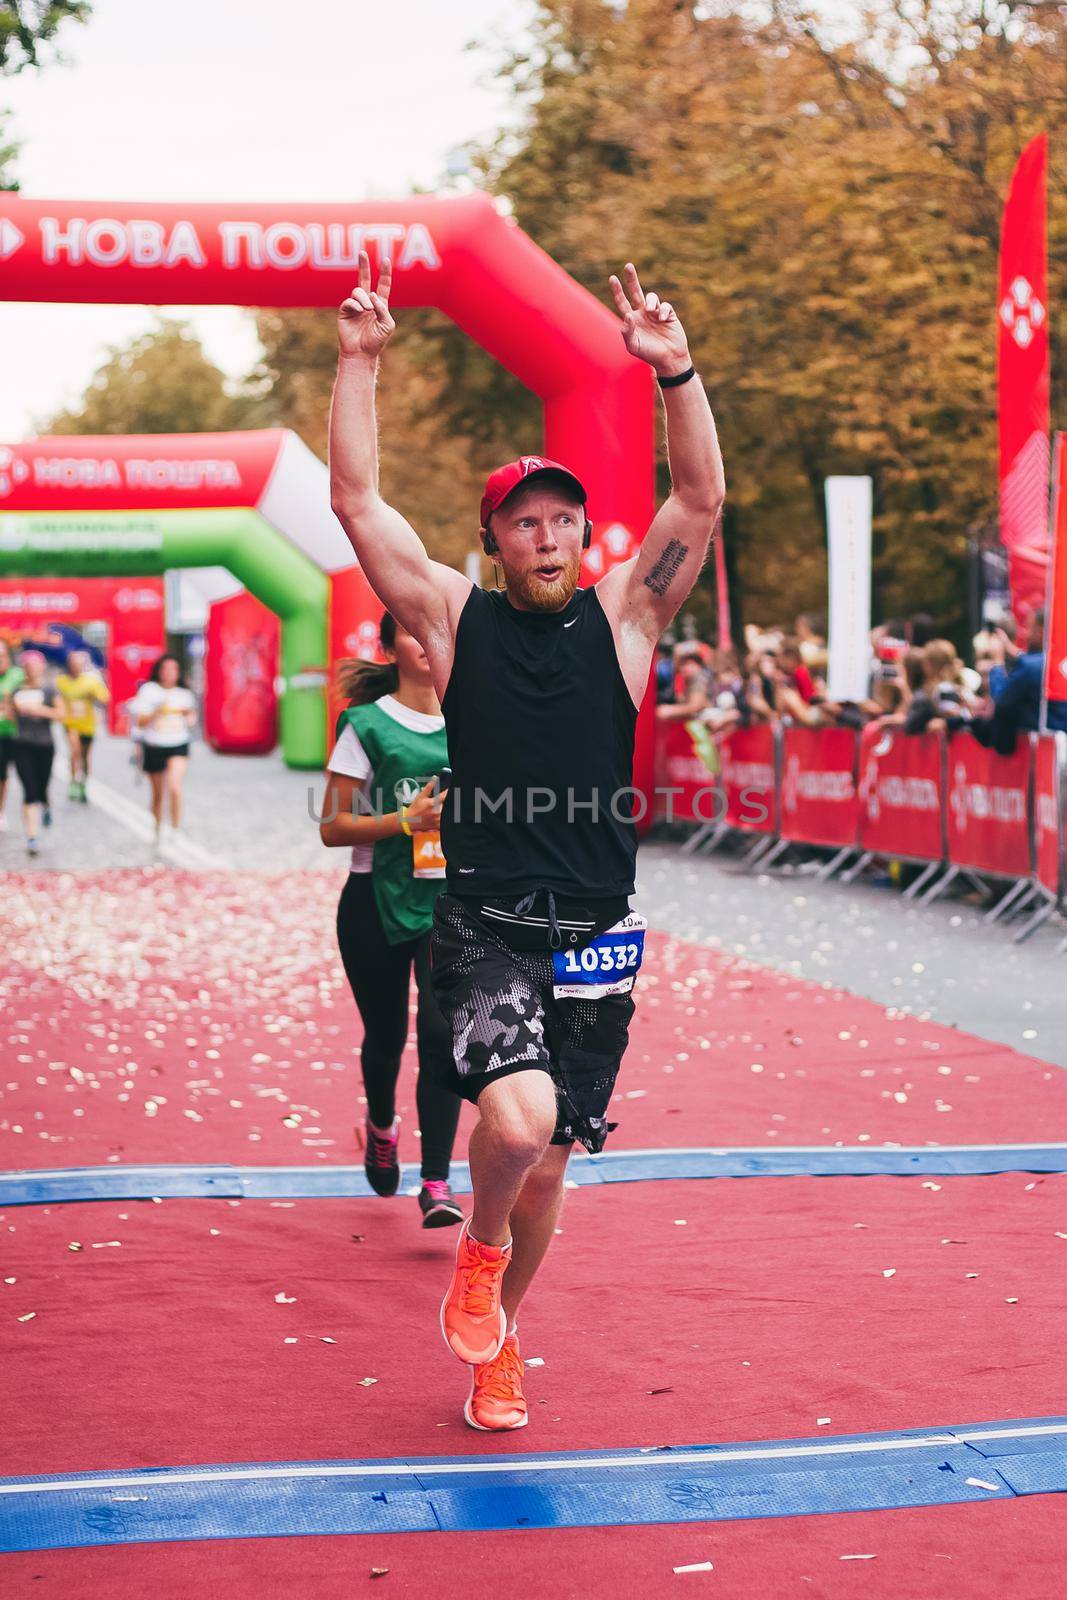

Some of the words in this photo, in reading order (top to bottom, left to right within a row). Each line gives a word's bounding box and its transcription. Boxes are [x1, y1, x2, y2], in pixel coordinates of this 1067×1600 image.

[39, 217, 206, 268] НОВА
[219, 221, 441, 270] ПОШТА
[564, 944, 638, 973] 10332
